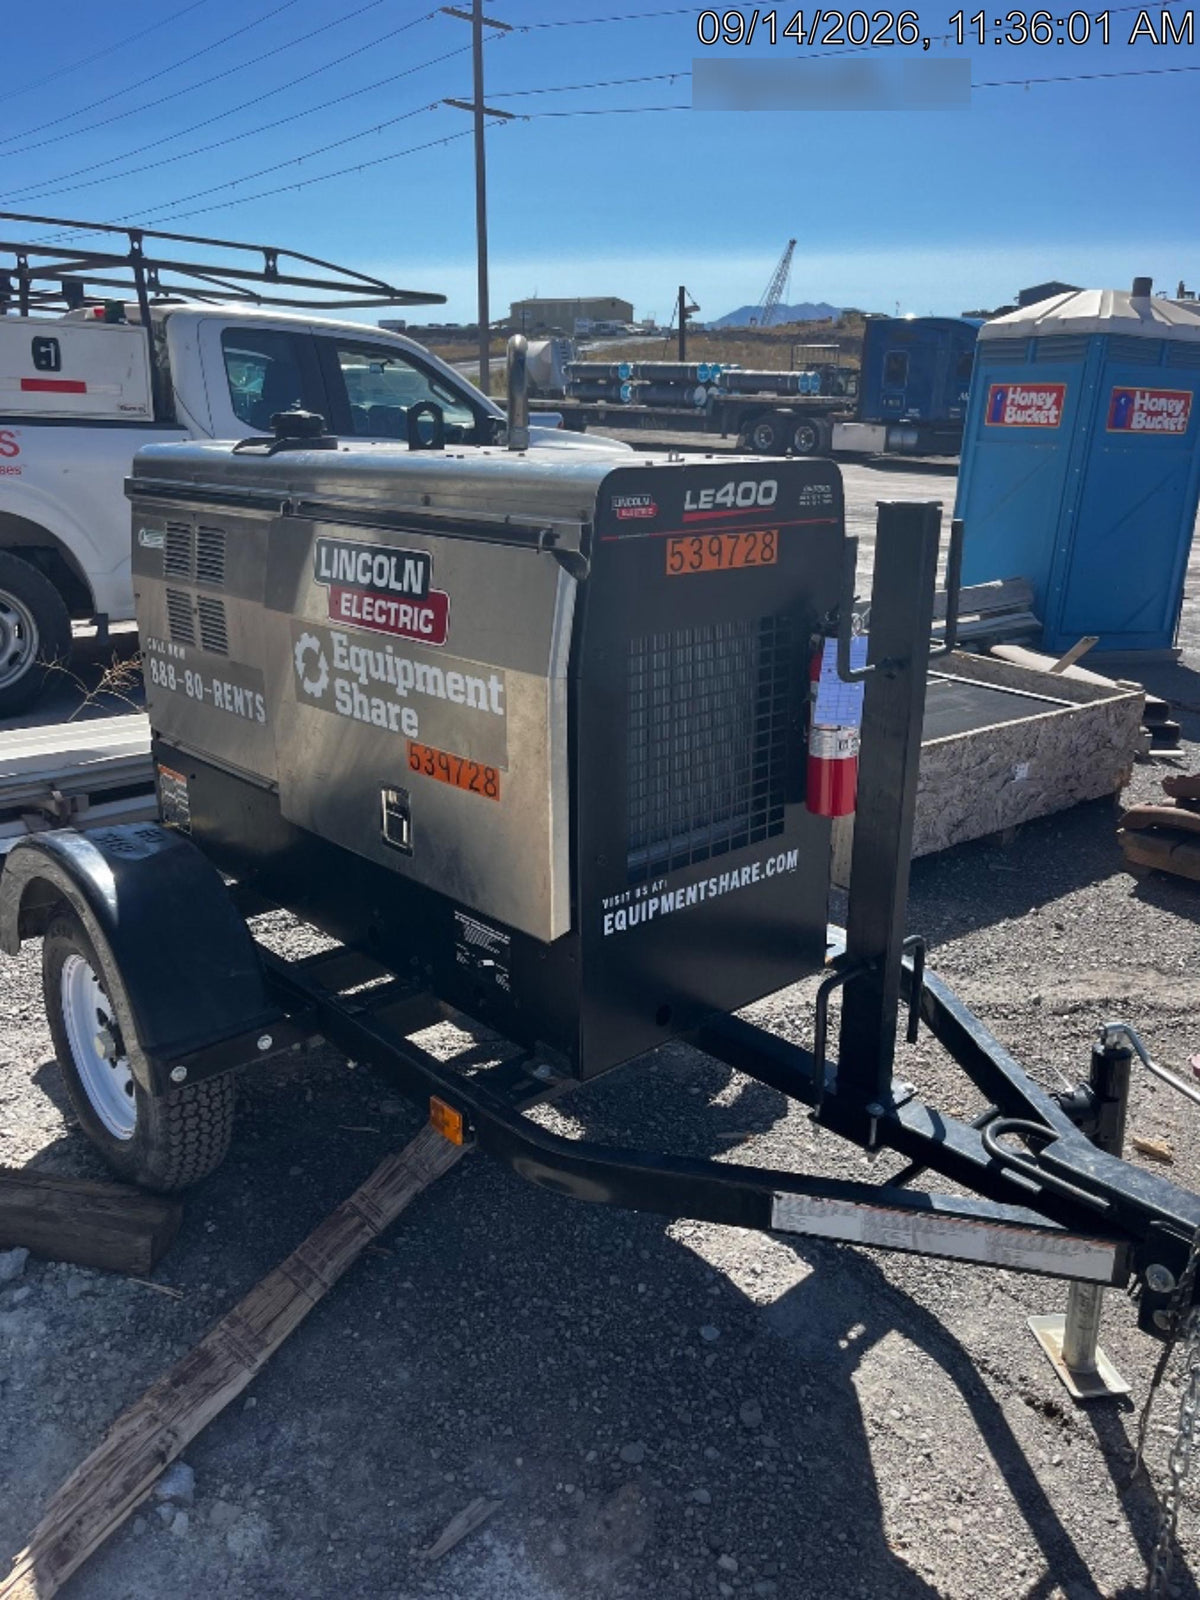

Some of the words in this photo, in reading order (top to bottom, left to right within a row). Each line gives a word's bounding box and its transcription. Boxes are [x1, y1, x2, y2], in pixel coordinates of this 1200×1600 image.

[1004, 405, 1059, 424] Bucket
[1006, 387, 1057, 407] Honey
[1134, 390, 1185, 414] Honey
[1131, 411, 1187, 431] Bucket
[683, 479, 778, 511] LE400
[319, 545, 424, 595] LINCOLN
[668, 530, 775, 573] 539728
[340, 592, 435, 634] ELECTRIC
[150, 657, 267, 724] 888-80-RENTS
[330, 631, 505, 716] Equipment
[333, 677, 419, 739] Share
[408, 742, 498, 798] 539728
[602, 889, 631, 910] VISIT
[603, 848, 800, 936] EQUIPMENTSHARE.COM
